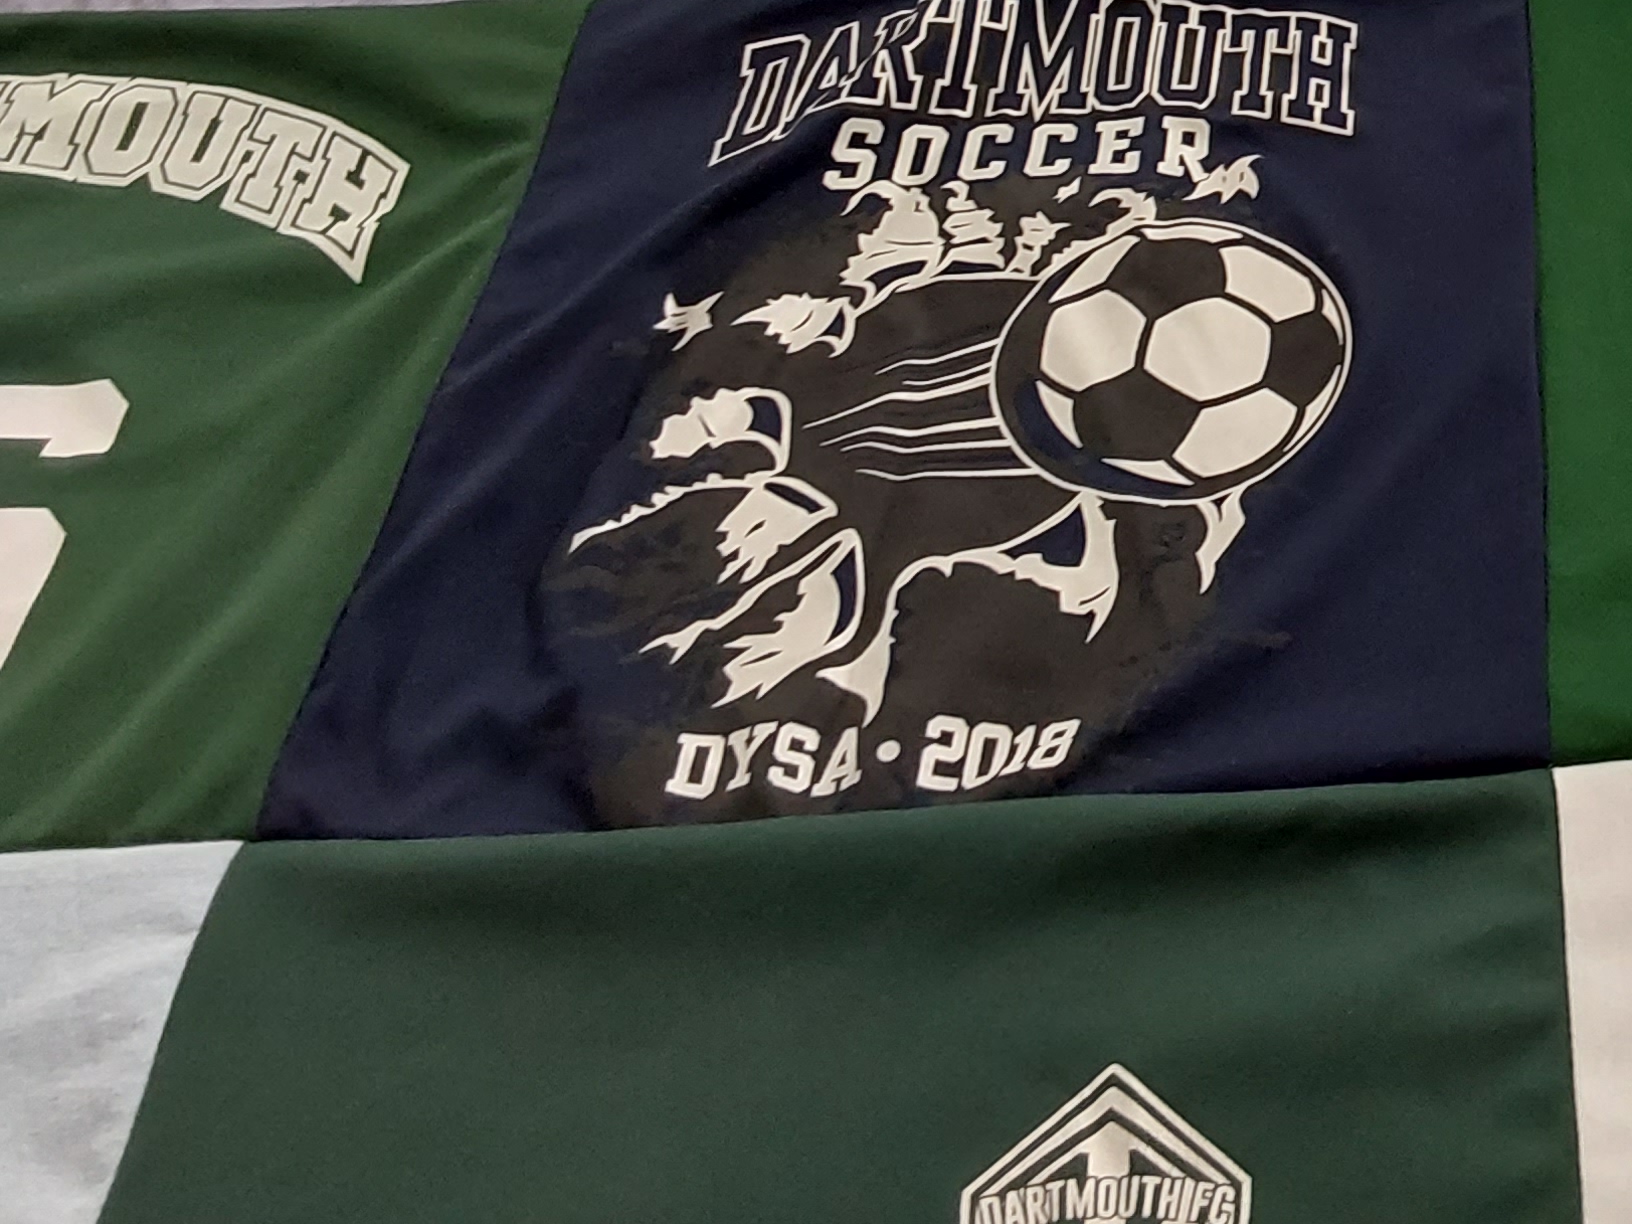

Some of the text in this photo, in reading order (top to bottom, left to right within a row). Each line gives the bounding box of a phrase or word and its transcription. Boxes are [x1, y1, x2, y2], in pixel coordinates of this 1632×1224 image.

[0, 72, 411, 284] MOUTH
[822, 116, 1213, 191] SOCCER
[665, 715, 1081, 800] DYSA 2018
[973, 1173, 1184, 1224] DARTMOUTH
